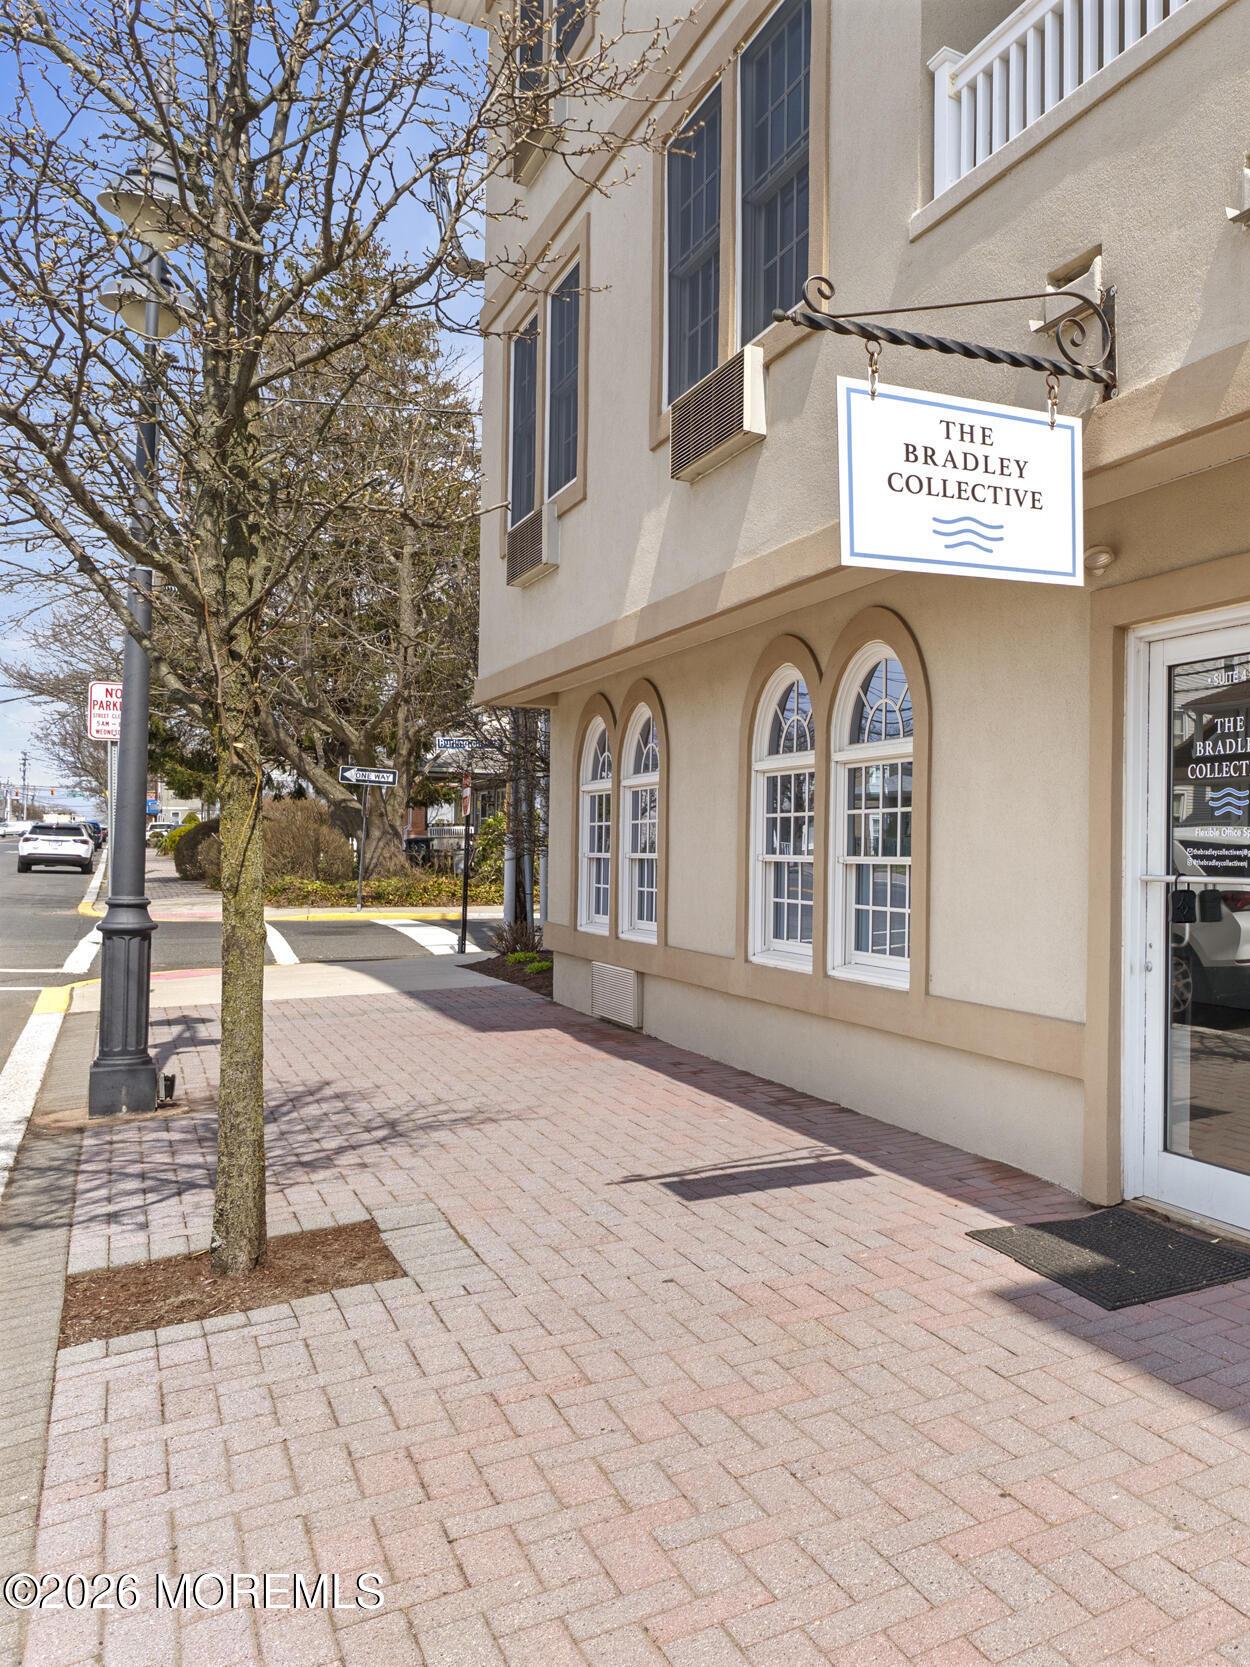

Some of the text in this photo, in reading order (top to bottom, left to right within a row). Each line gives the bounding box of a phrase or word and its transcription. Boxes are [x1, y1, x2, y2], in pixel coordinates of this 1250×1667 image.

[939, 420, 995, 446] THE
[903, 443, 1029, 479] BRADLEY
[887, 472, 1044, 510] COLLECTIVE
[1213, 671, 1239, 686] SUITE
[105, 687, 122, 699] NO
[1214, 716, 1245, 733] THE
[355, 771, 391, 781] ONE WAY
[1195, 827, 1220, 838] Flexible
[1221, 827, 1241, 837] Office
